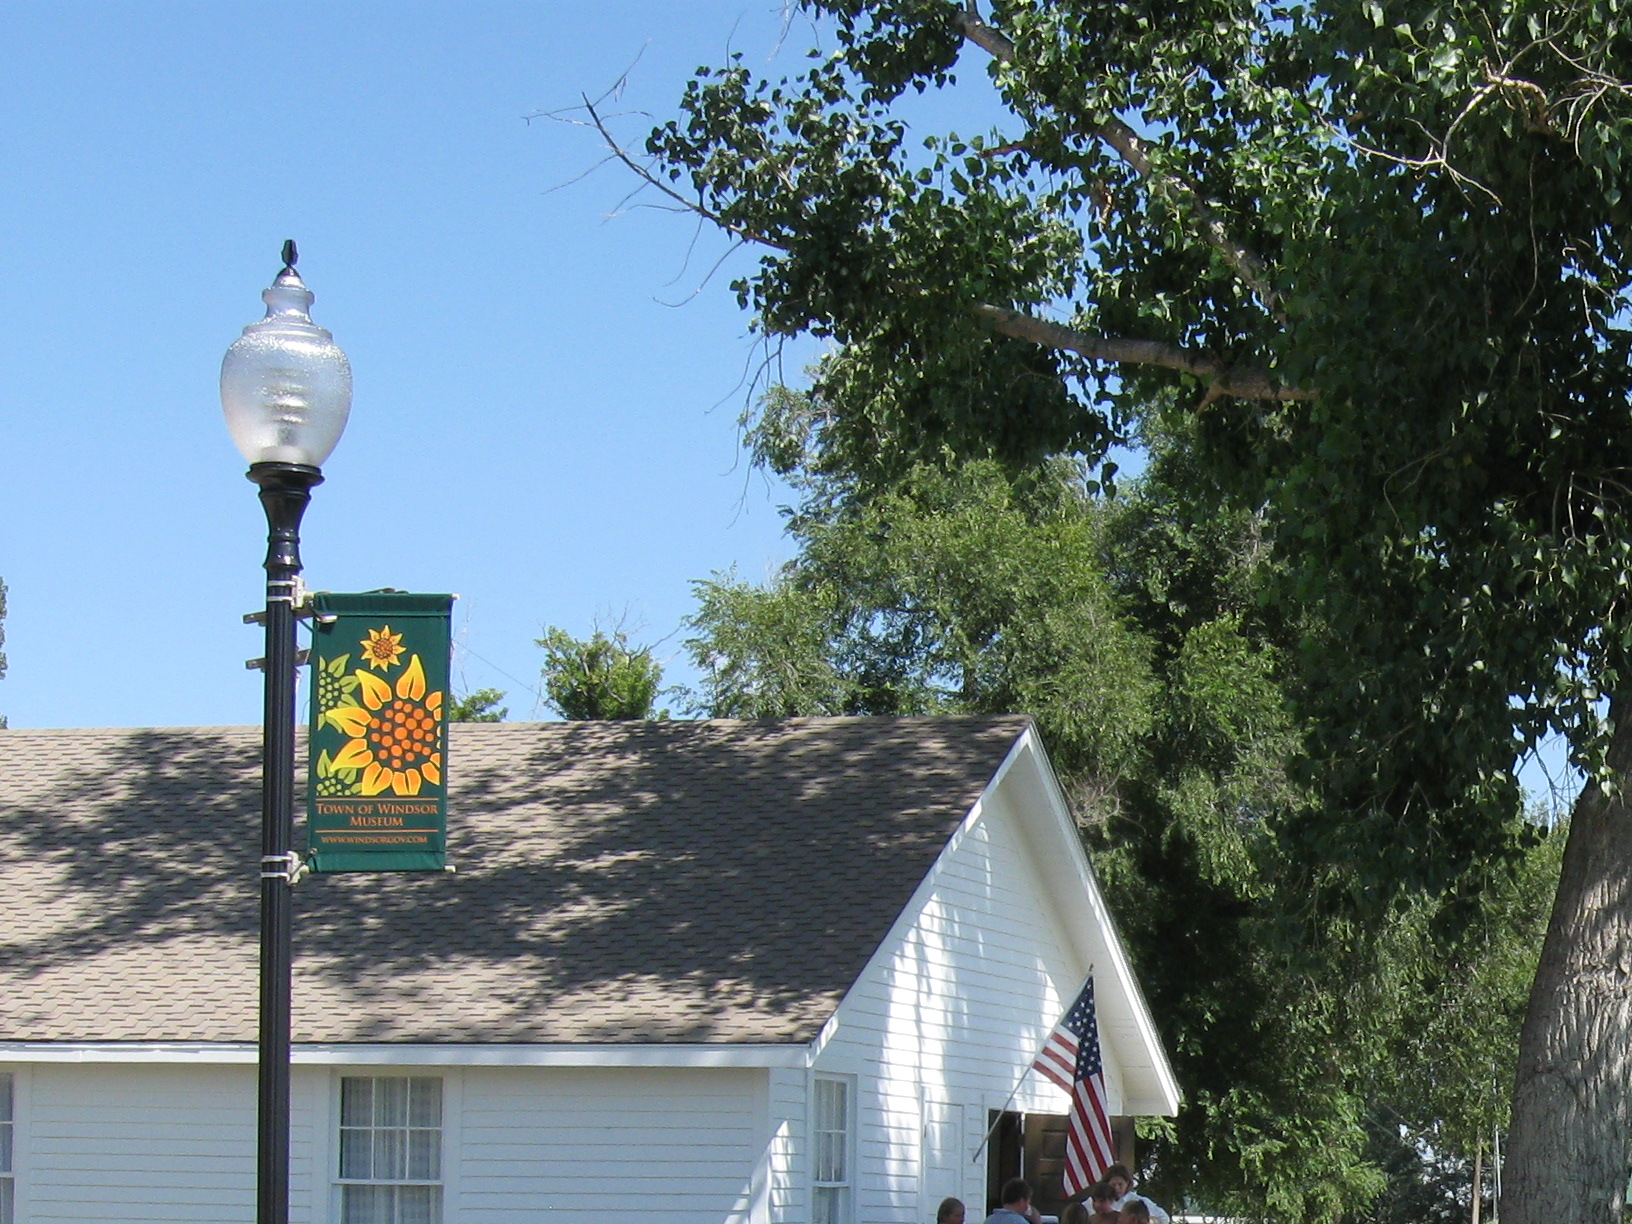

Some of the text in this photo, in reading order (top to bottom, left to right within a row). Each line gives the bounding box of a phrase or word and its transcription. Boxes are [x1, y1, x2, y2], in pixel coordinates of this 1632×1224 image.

[316, 803, 438, 815] TOWN OF WINDSOR
[350, 816, 404, 827] MUSEUM
